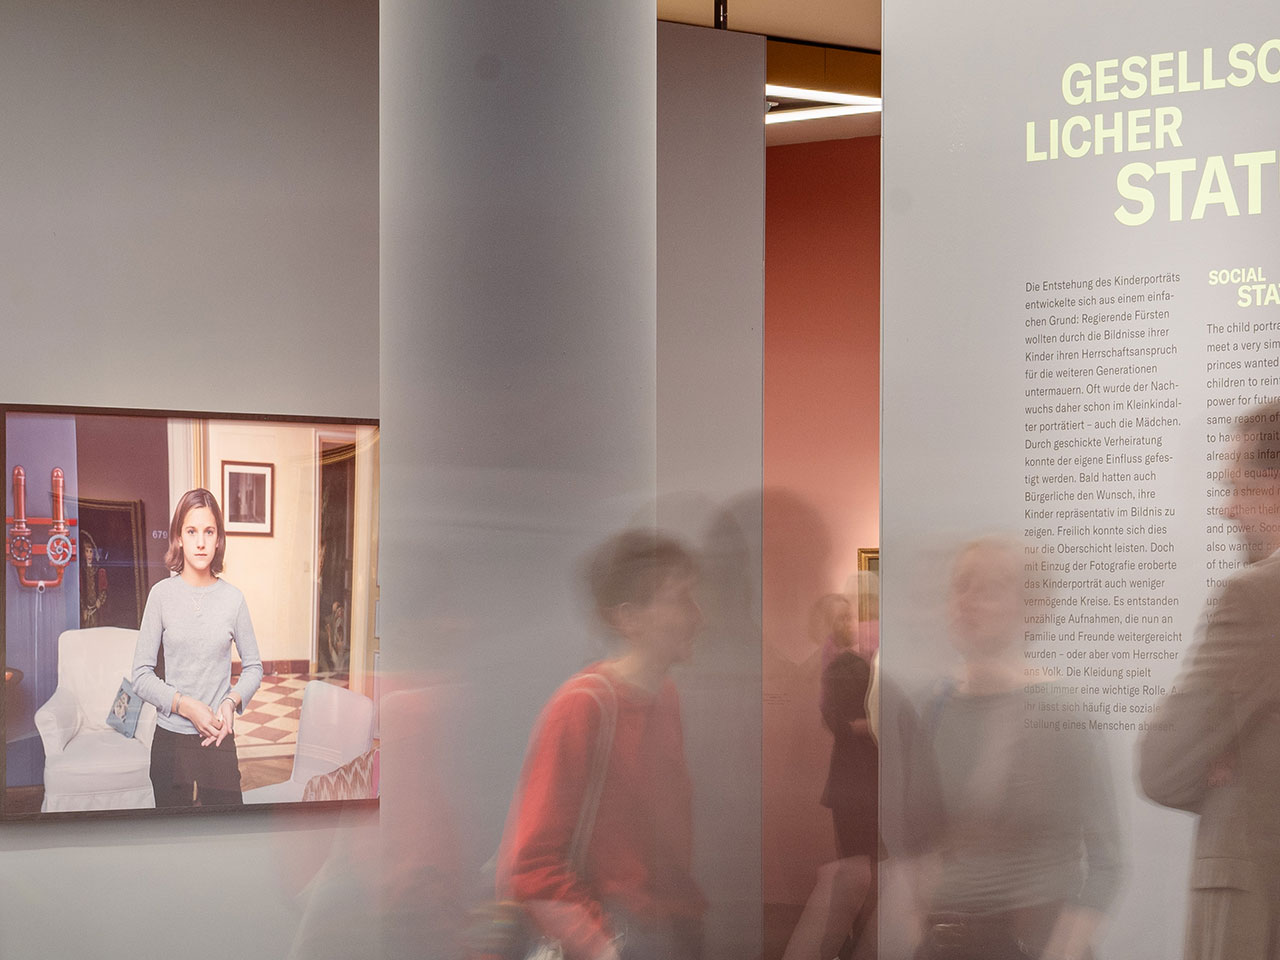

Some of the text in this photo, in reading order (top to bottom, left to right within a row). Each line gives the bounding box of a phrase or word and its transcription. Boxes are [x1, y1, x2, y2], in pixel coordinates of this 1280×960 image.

[1026, 106, 1183, 162] LICHER
[1025, 273, 1180, 292] Die Entstehung des Kinderporträts
[1208, 267, 1266, 286] SOCIAL
[1025, 291, 1174, 310] entwickelte sich aus einem einfa-
[1025, 309, 1170, 327] chen Grund: Regierende Fürsten
[1206, 323, 1224, 334] The
[1226, 321, 1250, 333] child
[1025, 327, 1169, 344] wollten durch die Bildnisse ihrer
[1025, 345, 1178, 362] Kinder ihren Herrschaftsanspruch
[1206, 341, 1230, 352] meet
[1233, 342, 1238, 351] a
[1241, 341, 1261, 352] very
[1025, 365, 1158, 379] für die weiteren Generationen
[1207, 359, 1242, 373] princes
[1244, 356, 1279, 368] wanted
[1025, 381, 1179, 397] untermauern. Oft wurde der Nach-
[1206, 377, 1245, 388] children
[1248, 376, 1258, 387] to
[1025, 398, 1182, 414] wuchs daher schon im Kleinkindal-
[1206, 397, 1235, 409] power
[1238, 394, 1251, 405] for
[1025, 416, 1181, 433] ter porträtiert auch die Mädchen.
[1025, 435, 1162, 450] Durch geschickte Verheiratung
[1024, 452, 1173, 467] konnte der eigene Einfluss gefes-
[1024, 470, 1156, 486] tigt werden. Bald hatten auch
[1024, 488, 1156, 503] Bürgerliche den Wunsch, ihre
[1024, 507, 1175, 521] Kinder repräsentativ im Bildnis zu
[1024, 524, 1167, 539] zeigen. Freilich konnte sich dies
[1024, 542, 1174, 554] nur die Oberschicht leisten. Doch
[1024, 560, 1177, 573] mit Einzug der Fotografie eroberte
[1024, 578, 1165, 591] das Kinderporträt auch weniger
[1023, 595, 1179, 608] vermögende Kreise. Es entstanden
[1024, 613, 1173, 626] unzählige Aufnahmen, die nun an
[1024, 631, 1182, 644] Familie und Freunde weitergereicht
[1023, 648, 1178, 660] wurden oder aber vom Herrscher
